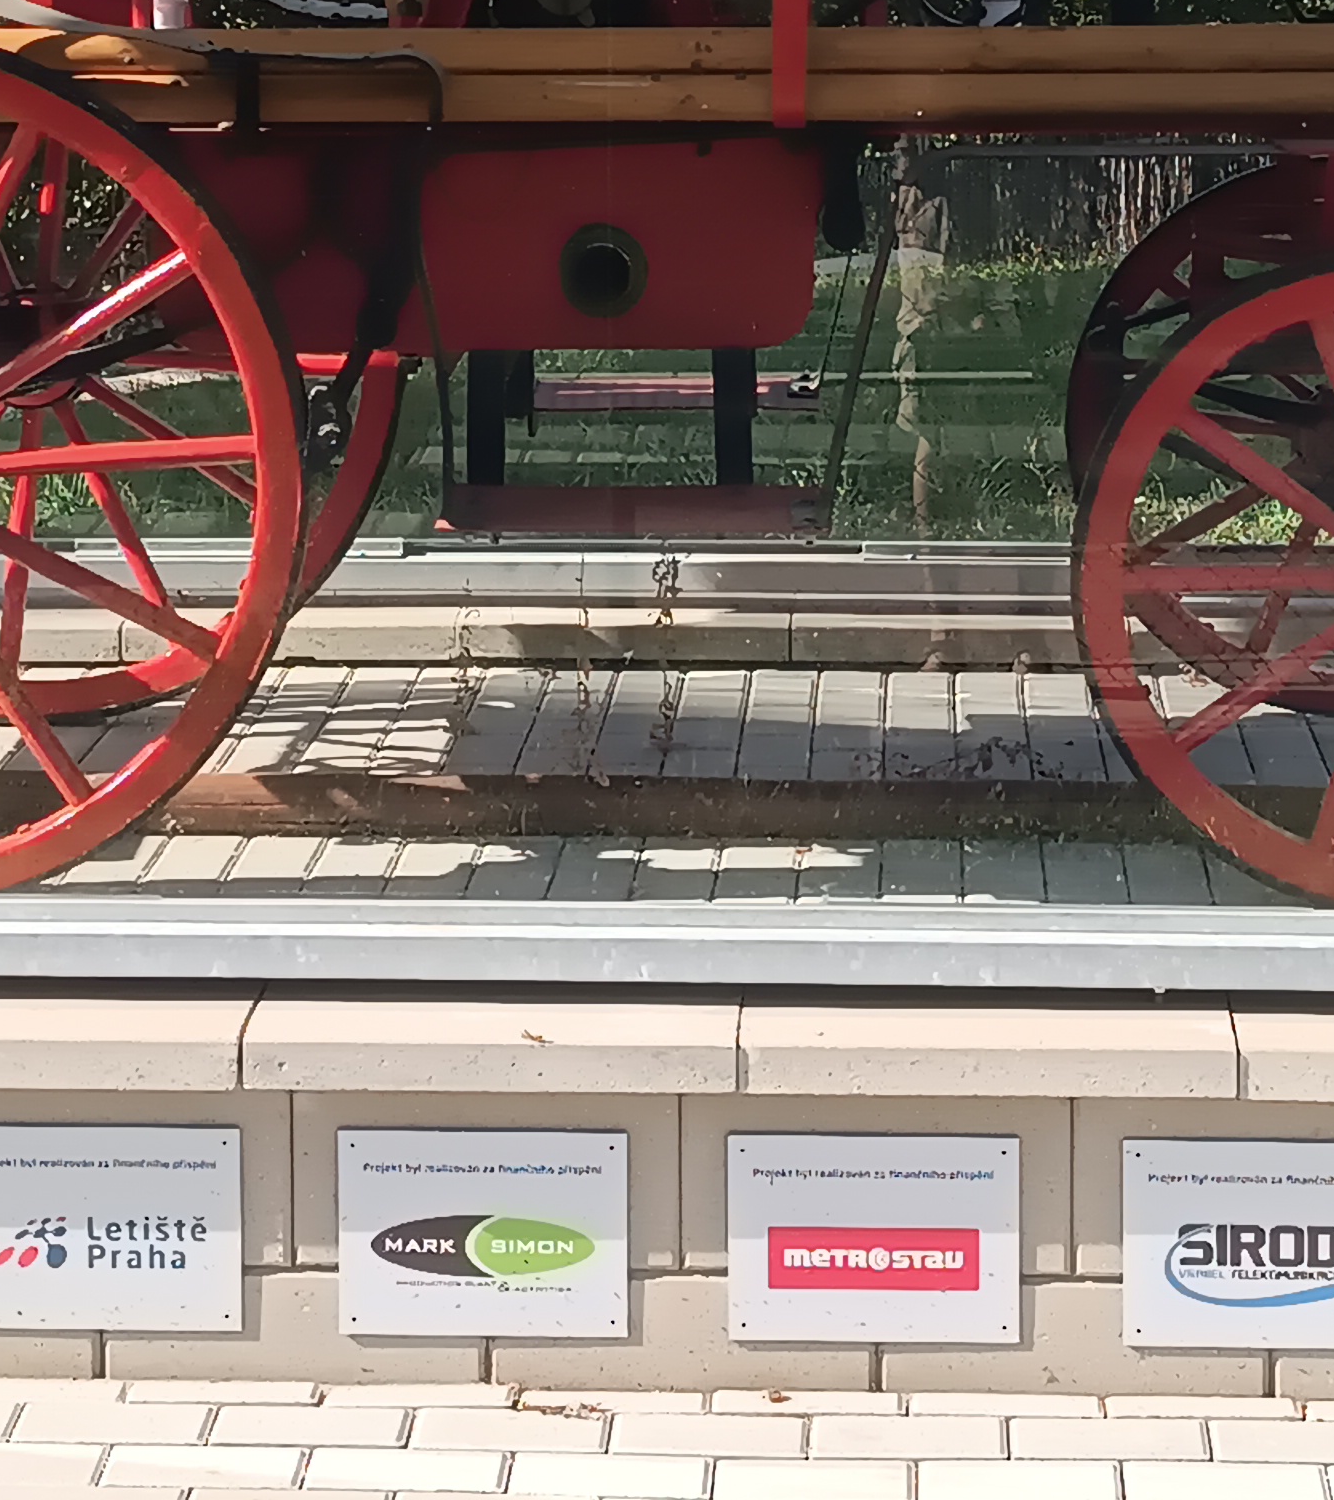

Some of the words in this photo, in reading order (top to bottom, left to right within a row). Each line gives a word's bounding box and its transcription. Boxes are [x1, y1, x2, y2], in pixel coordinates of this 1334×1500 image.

[87, 1216, 207, 1241] Letiště
[384, 1238, 456, 1254] MARK
[490, 1239, 573, 1254] SIMON
[87, 1244, 186, 1269] Praha
